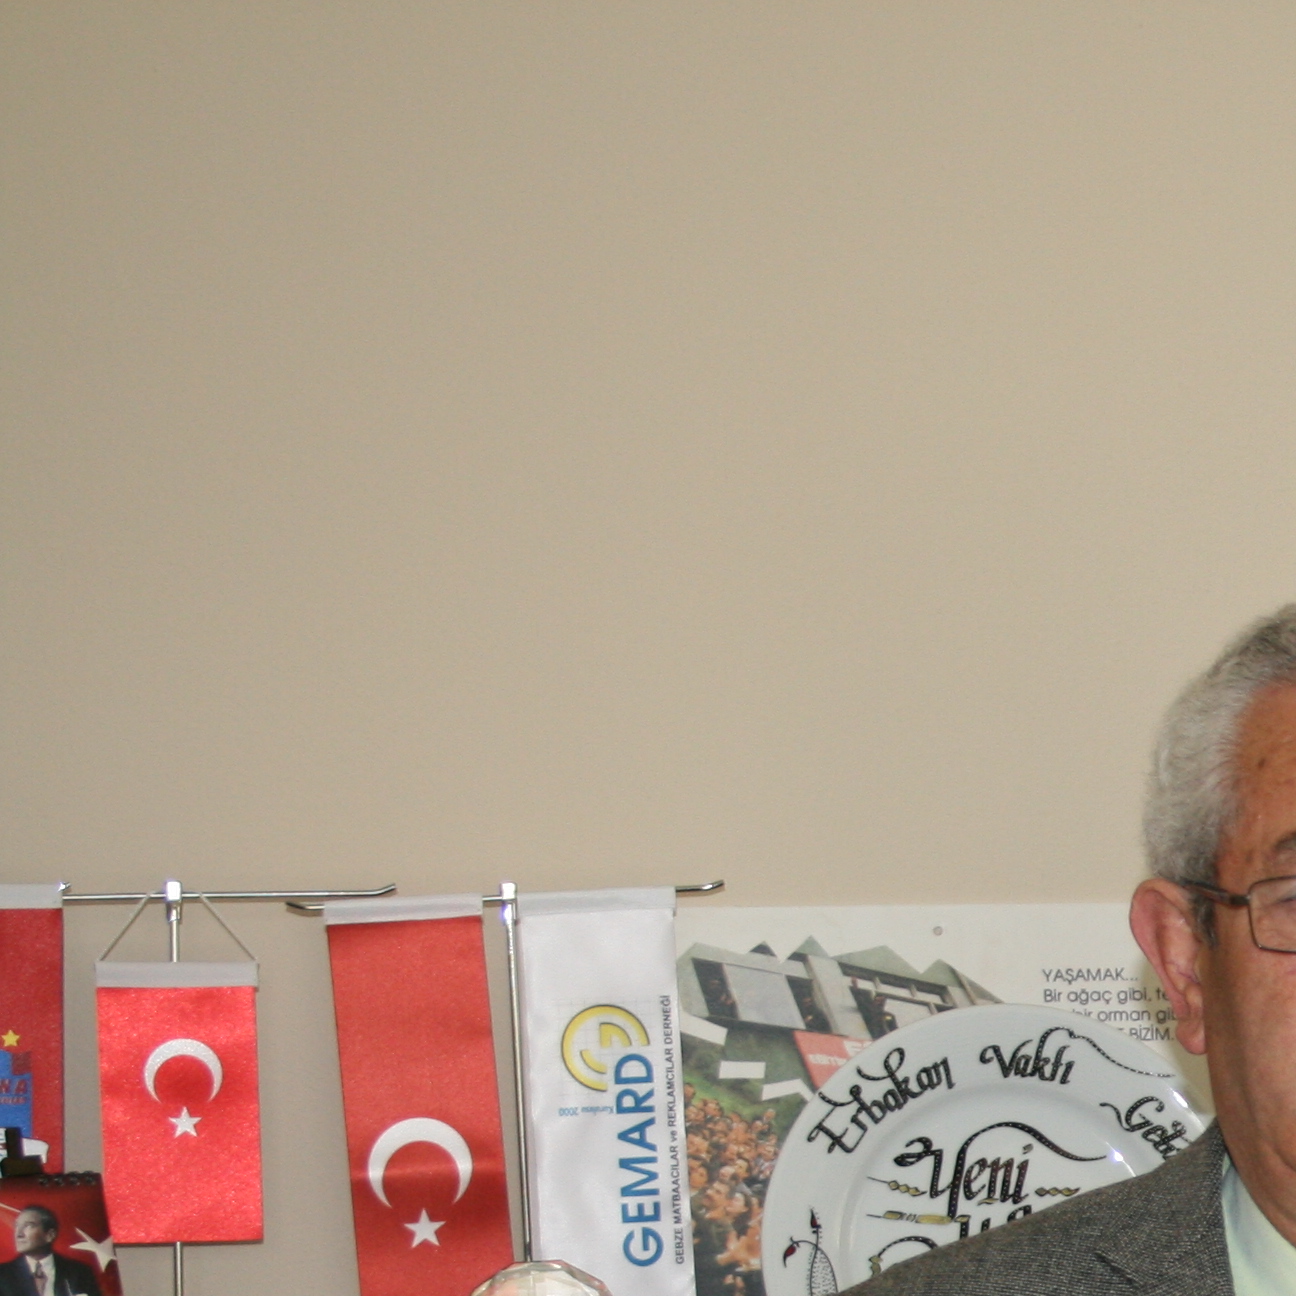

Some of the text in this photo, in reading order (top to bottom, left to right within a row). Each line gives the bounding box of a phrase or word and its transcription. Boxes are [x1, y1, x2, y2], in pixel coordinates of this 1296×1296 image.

[1043, 967, 1139, 985] YAŞAMAK...
[1044, 988, 1063, 1003] Bir
[1067, 988, 1112, 1005] ağaç
[1097, 1010, 1148, 1022] orman
[660, 995, 685, 1264] GEBZE MATBAACILAR ve REKLAMCILAR DERNEĞİ
[807, 1047, 956, 1155] Erbakan
[614, 1052, 665, 1267] GEMARD
